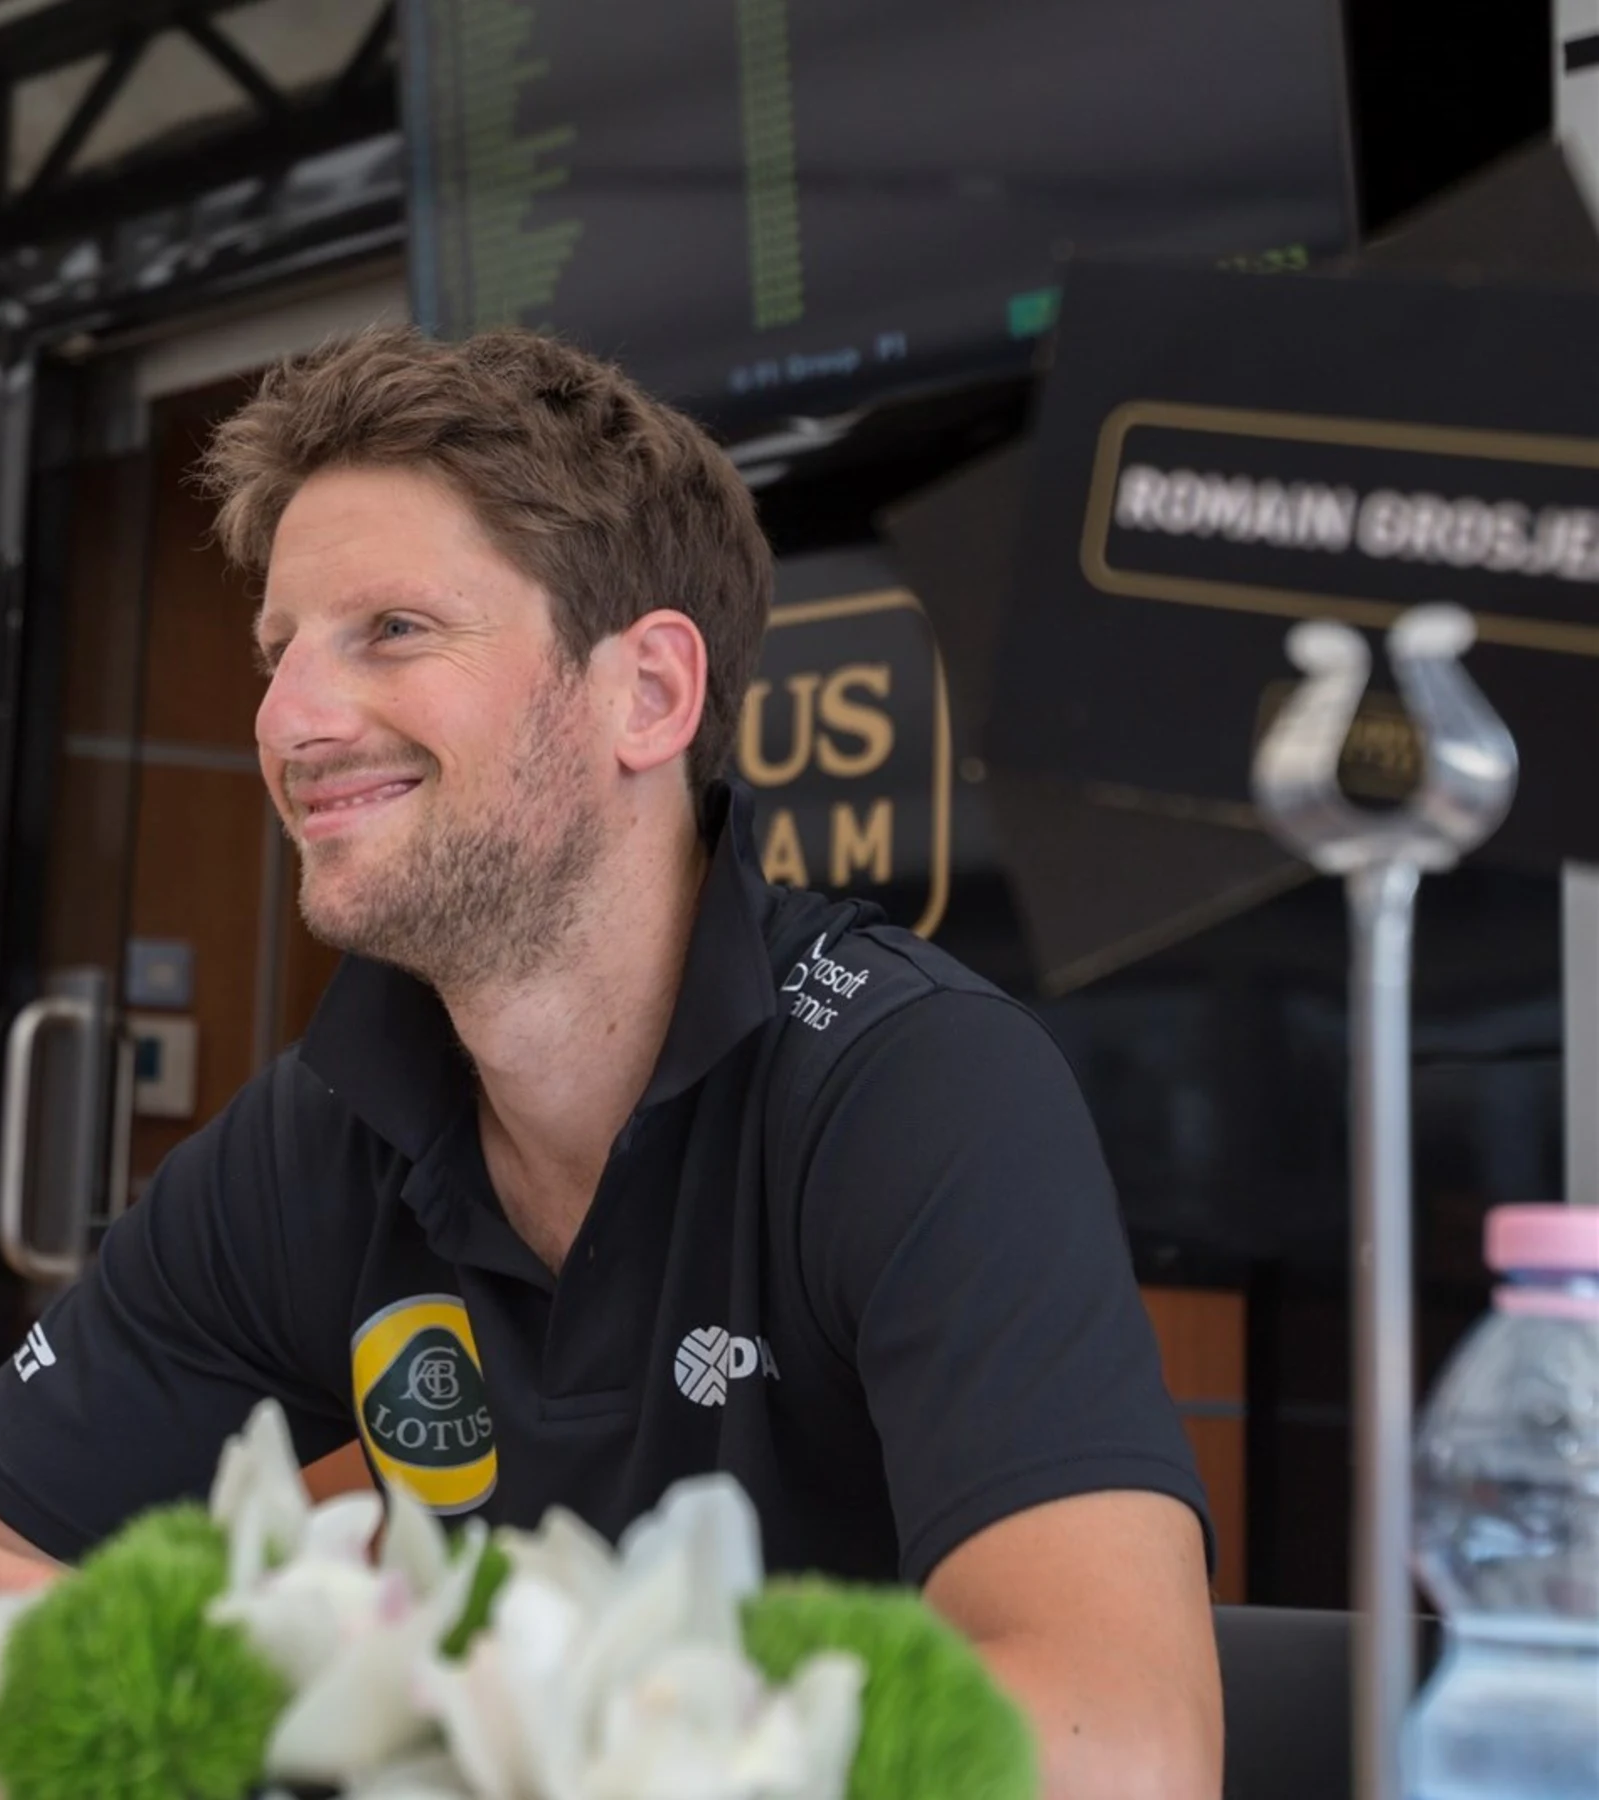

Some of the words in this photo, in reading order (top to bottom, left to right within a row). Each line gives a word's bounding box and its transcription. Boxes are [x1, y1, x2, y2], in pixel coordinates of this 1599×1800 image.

[1116, 464, 1358, 553] ROMAIN
[763, 799, 893, 889] AM
[371, 1404, 493, 1451] LOTUS
